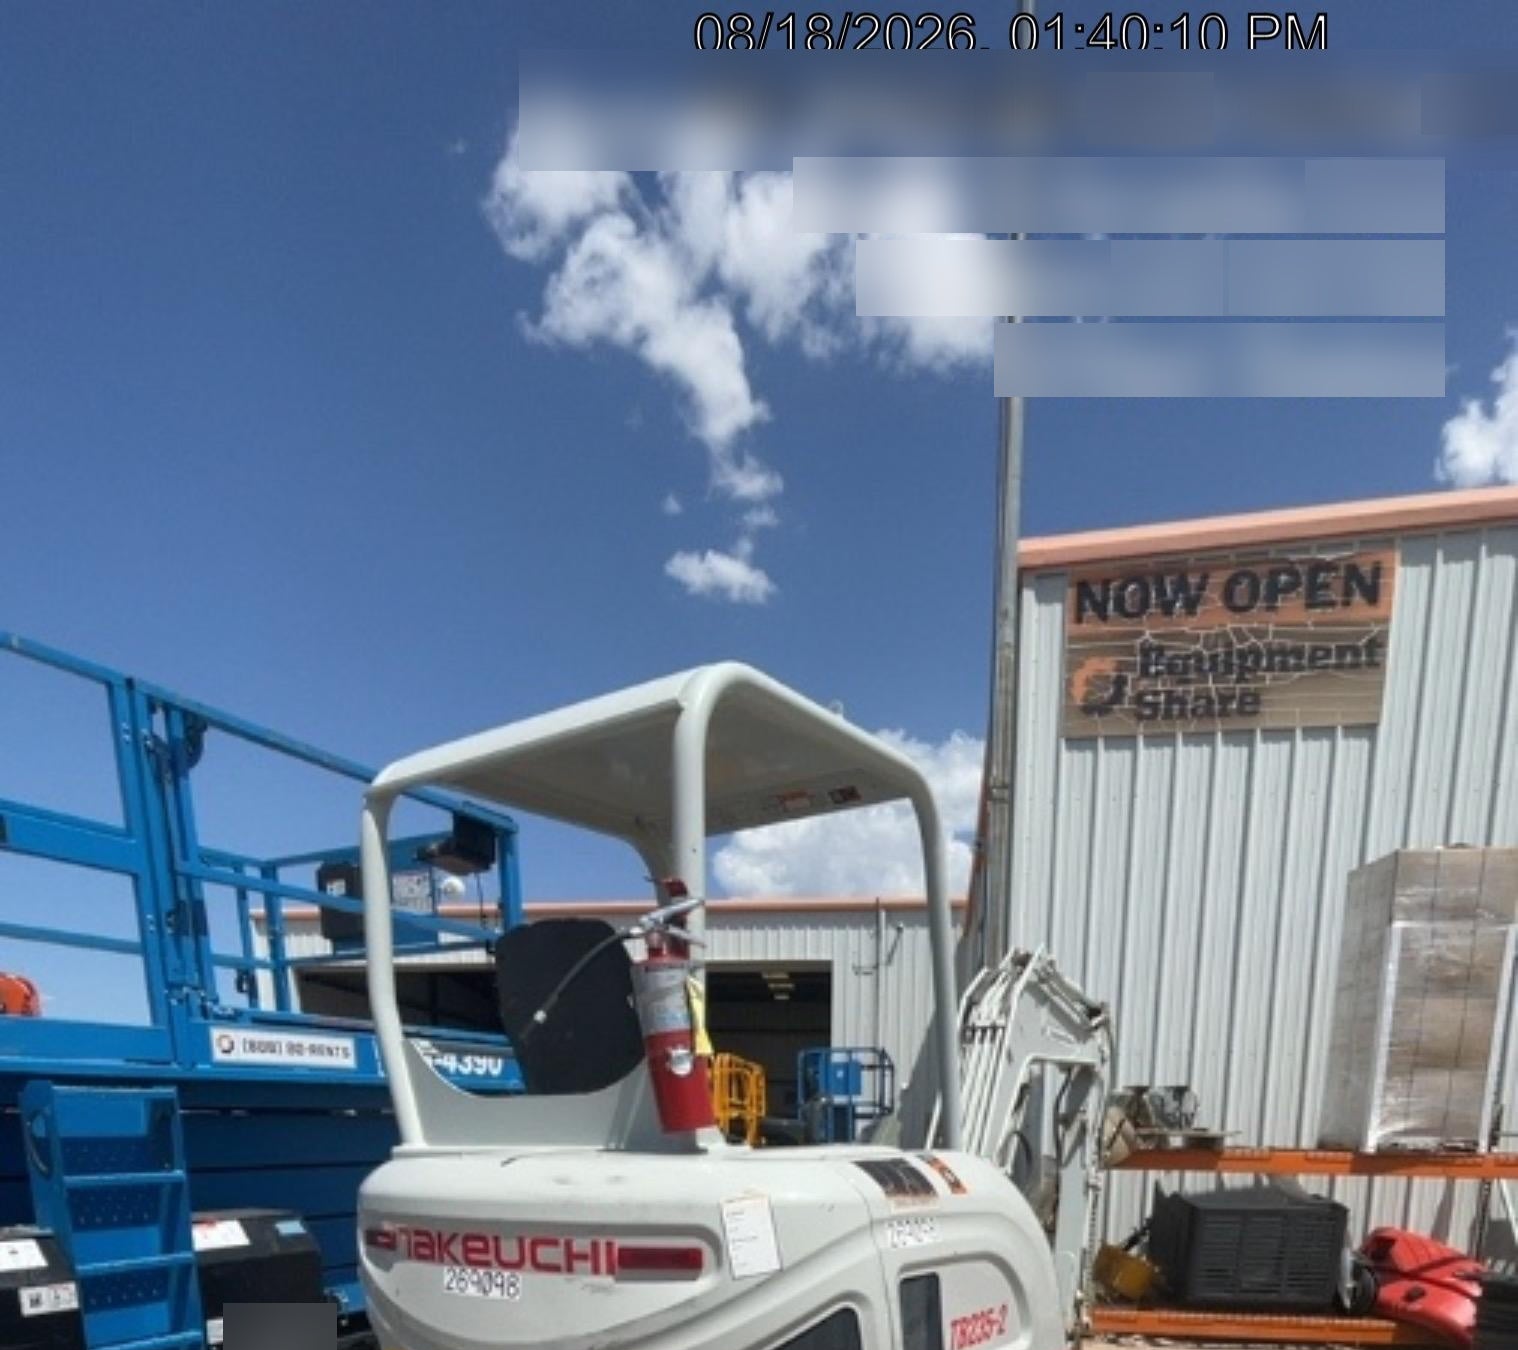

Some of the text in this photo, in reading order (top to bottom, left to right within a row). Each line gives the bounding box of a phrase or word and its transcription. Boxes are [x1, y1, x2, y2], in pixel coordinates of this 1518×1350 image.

[1074, 559, 1383, 624] NOW OPEN
[1138, 637, 1384, 684] Equipment
[1134, 687, 1262, 721] Share
